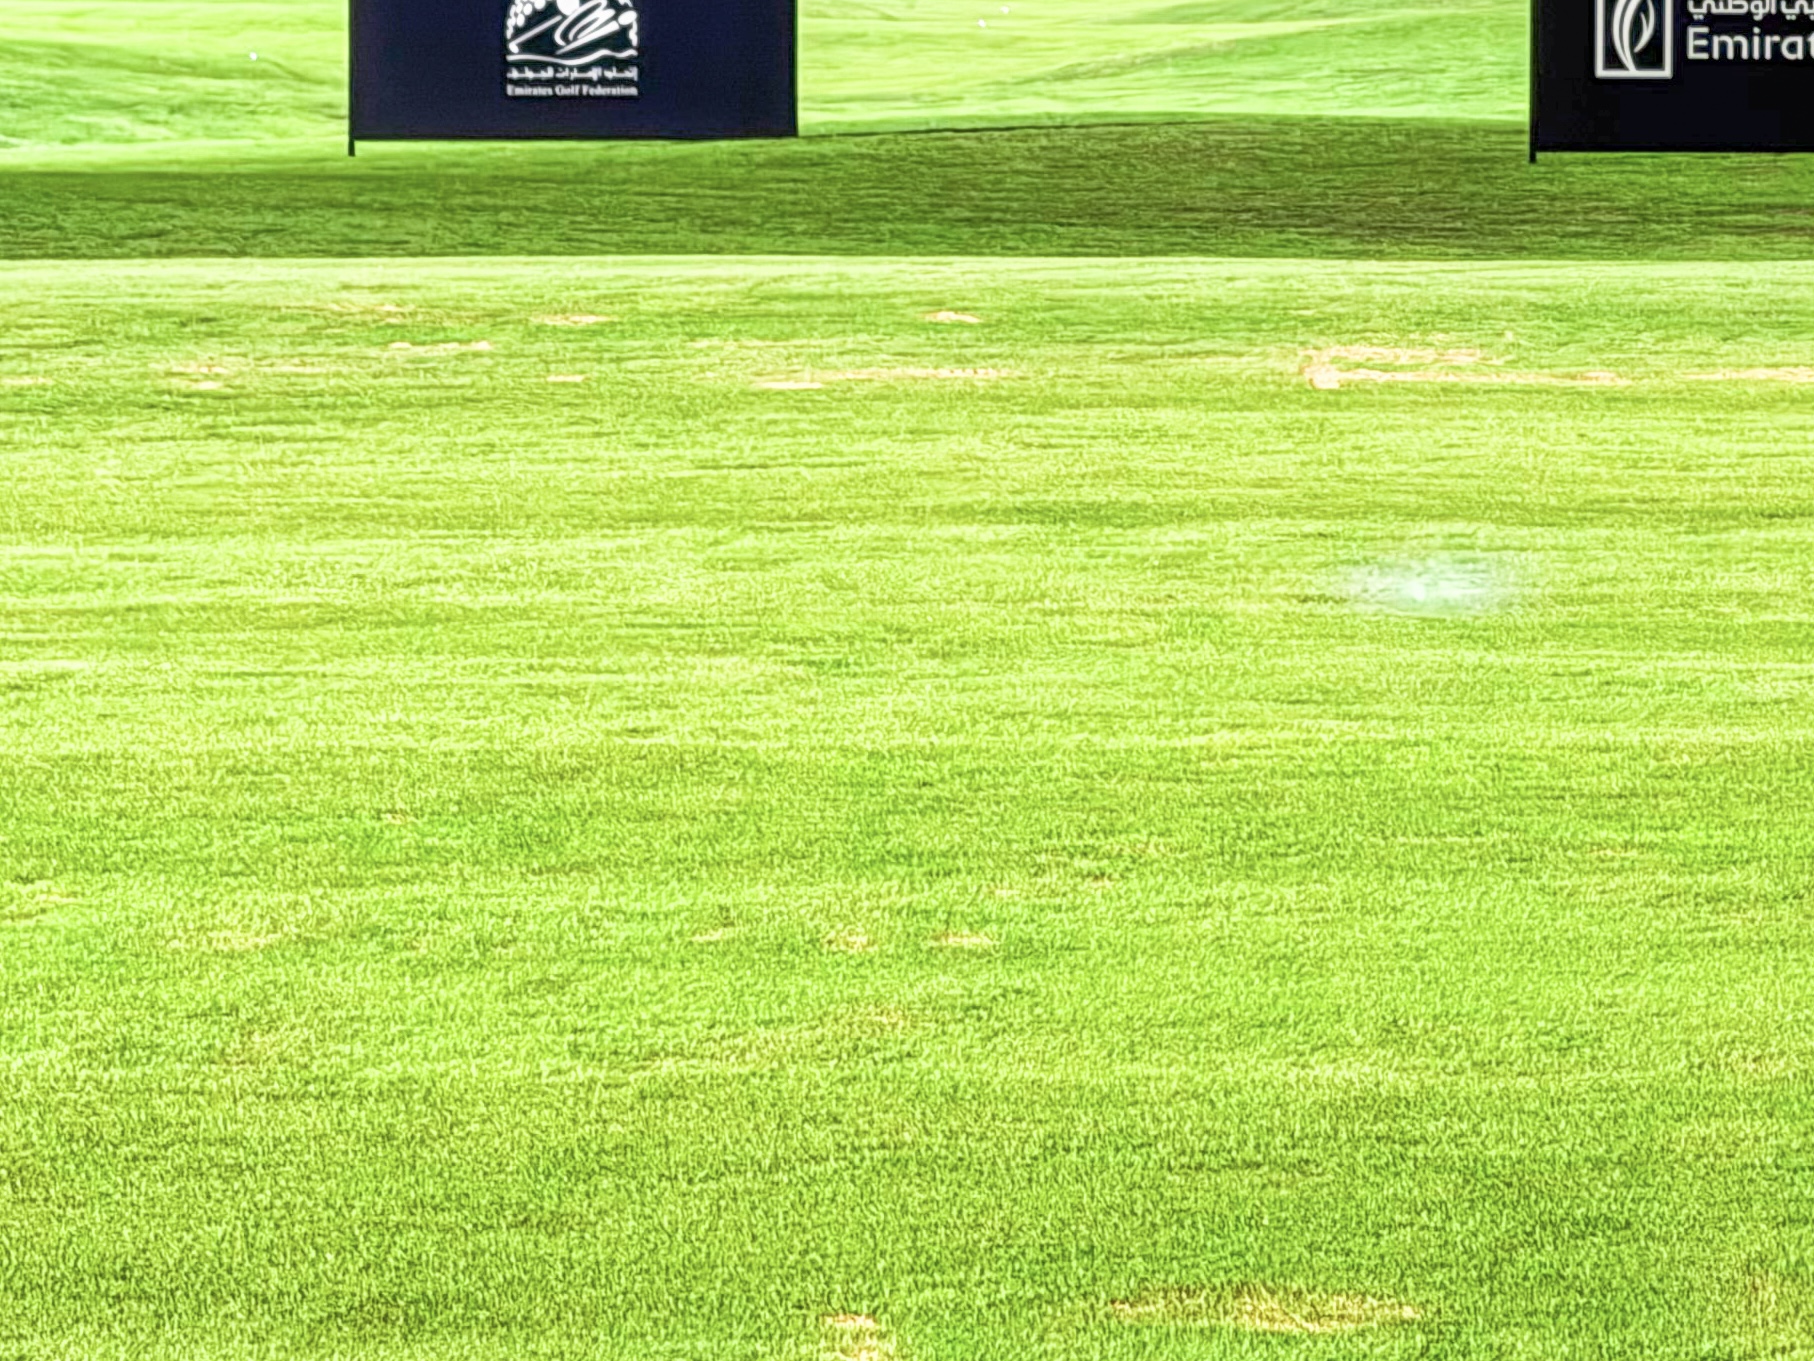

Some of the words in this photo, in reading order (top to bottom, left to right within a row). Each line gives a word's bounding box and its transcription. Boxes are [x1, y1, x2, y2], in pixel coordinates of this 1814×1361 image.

[506, 84, 553, 96] Emirates
[554, 84, 580, 96] Golf
[581, 84, 638, 96] Federation
